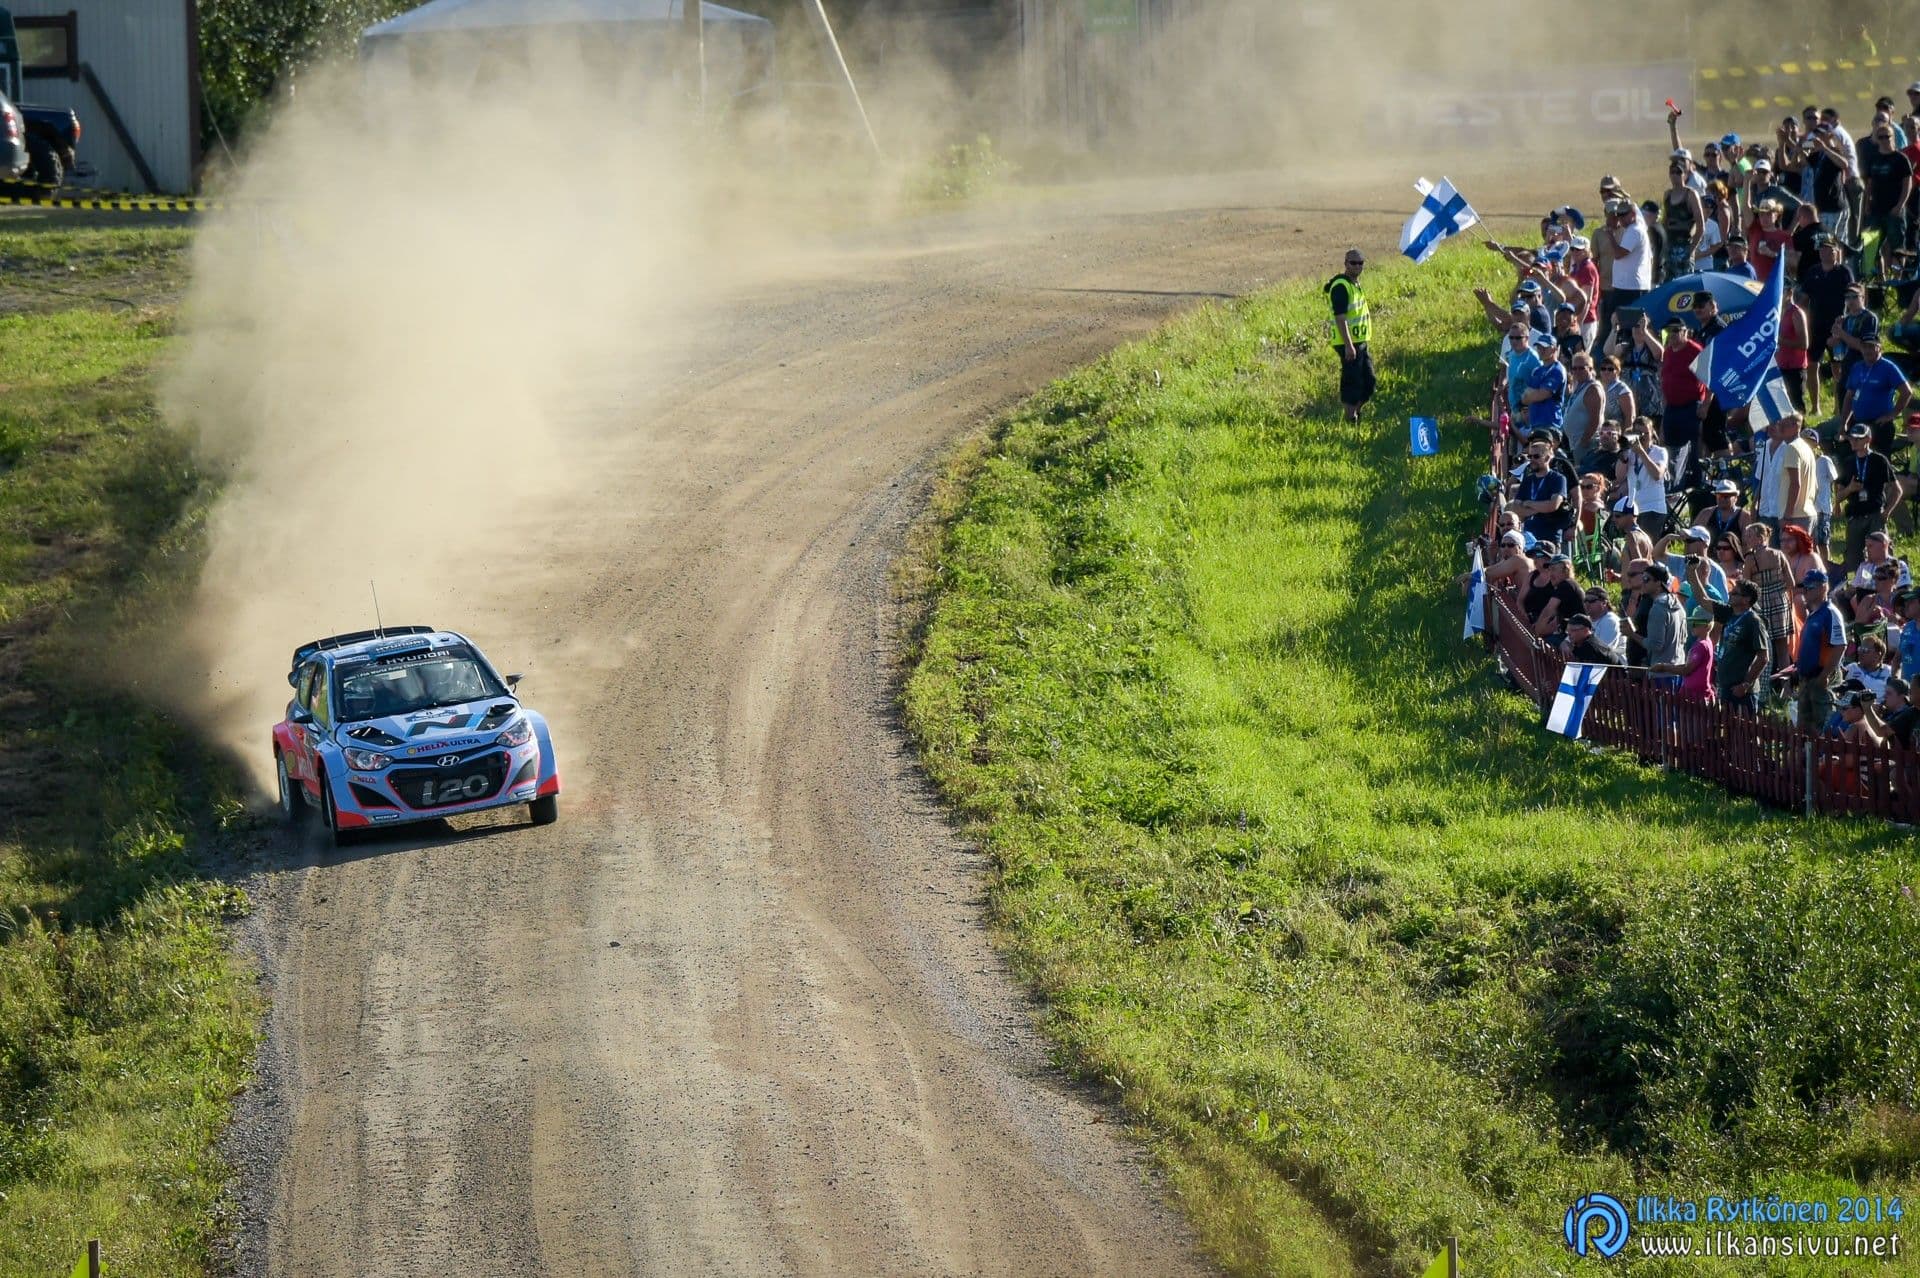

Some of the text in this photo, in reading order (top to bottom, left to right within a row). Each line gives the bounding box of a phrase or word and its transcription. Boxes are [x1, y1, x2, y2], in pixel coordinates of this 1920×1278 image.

[1590, 87, 1669, 122] OIL
[386, 650, 450, 665] HYUNDAI
[416, 738, 481, 753] HELIX ULTRA
